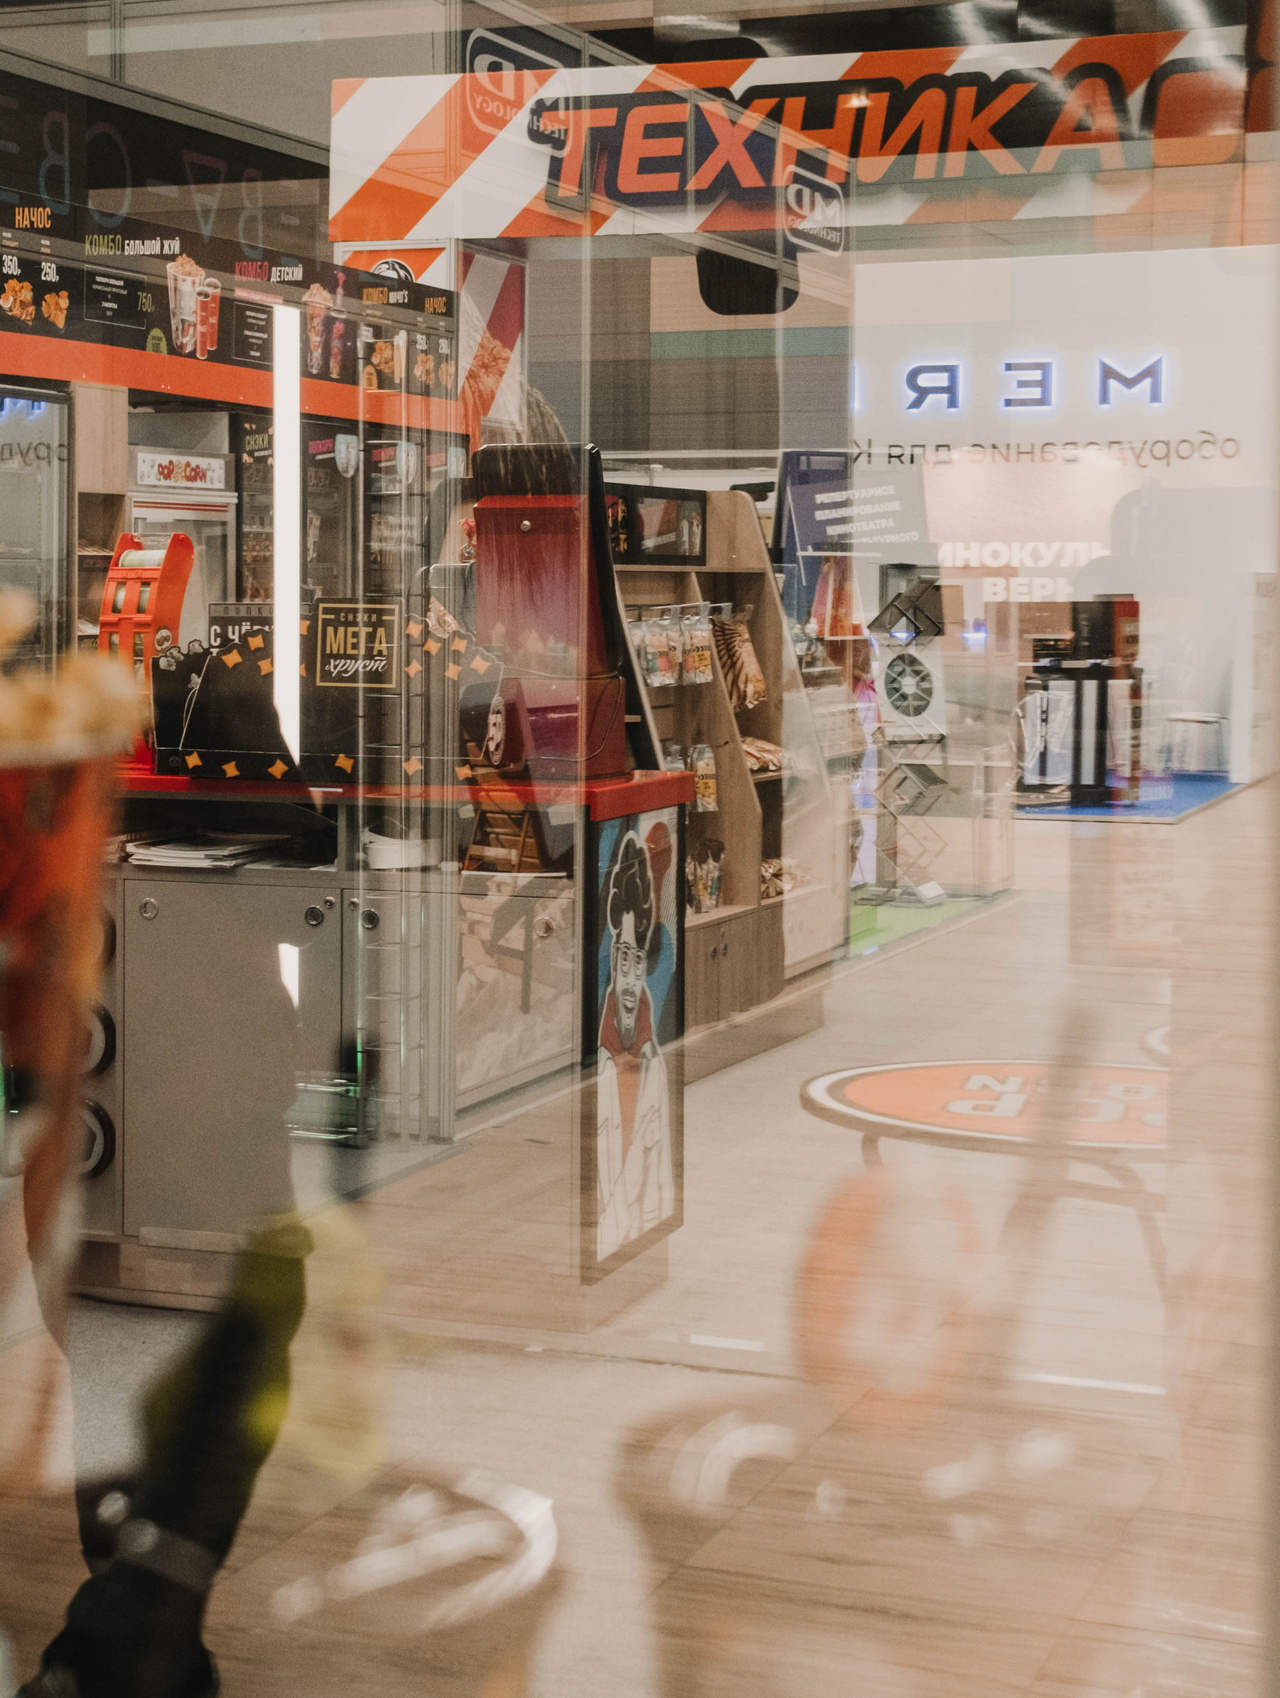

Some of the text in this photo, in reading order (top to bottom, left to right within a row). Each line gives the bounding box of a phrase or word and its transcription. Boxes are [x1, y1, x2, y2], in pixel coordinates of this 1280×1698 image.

[540, 78, 1125, 198] ТЕХНИКА
[15, 207, 51, 229] НАЧОС
[85, 234, 180, 256] КОМБО БОЛЬШОЙ ЖУЙ
[235, 261, 303, 283] КОМБО ДЕТСКИЙ
[424, 297, 446, 314] НАЧОС
[245, 433, 269, 451] СНЭКИ
[157, 459, 207, 484] POP CORN
[340, 612, 377, 622] СНЭКИ
[325, 626, 388, 656] МЕГА
[324, 656, 389, 677] хруст
